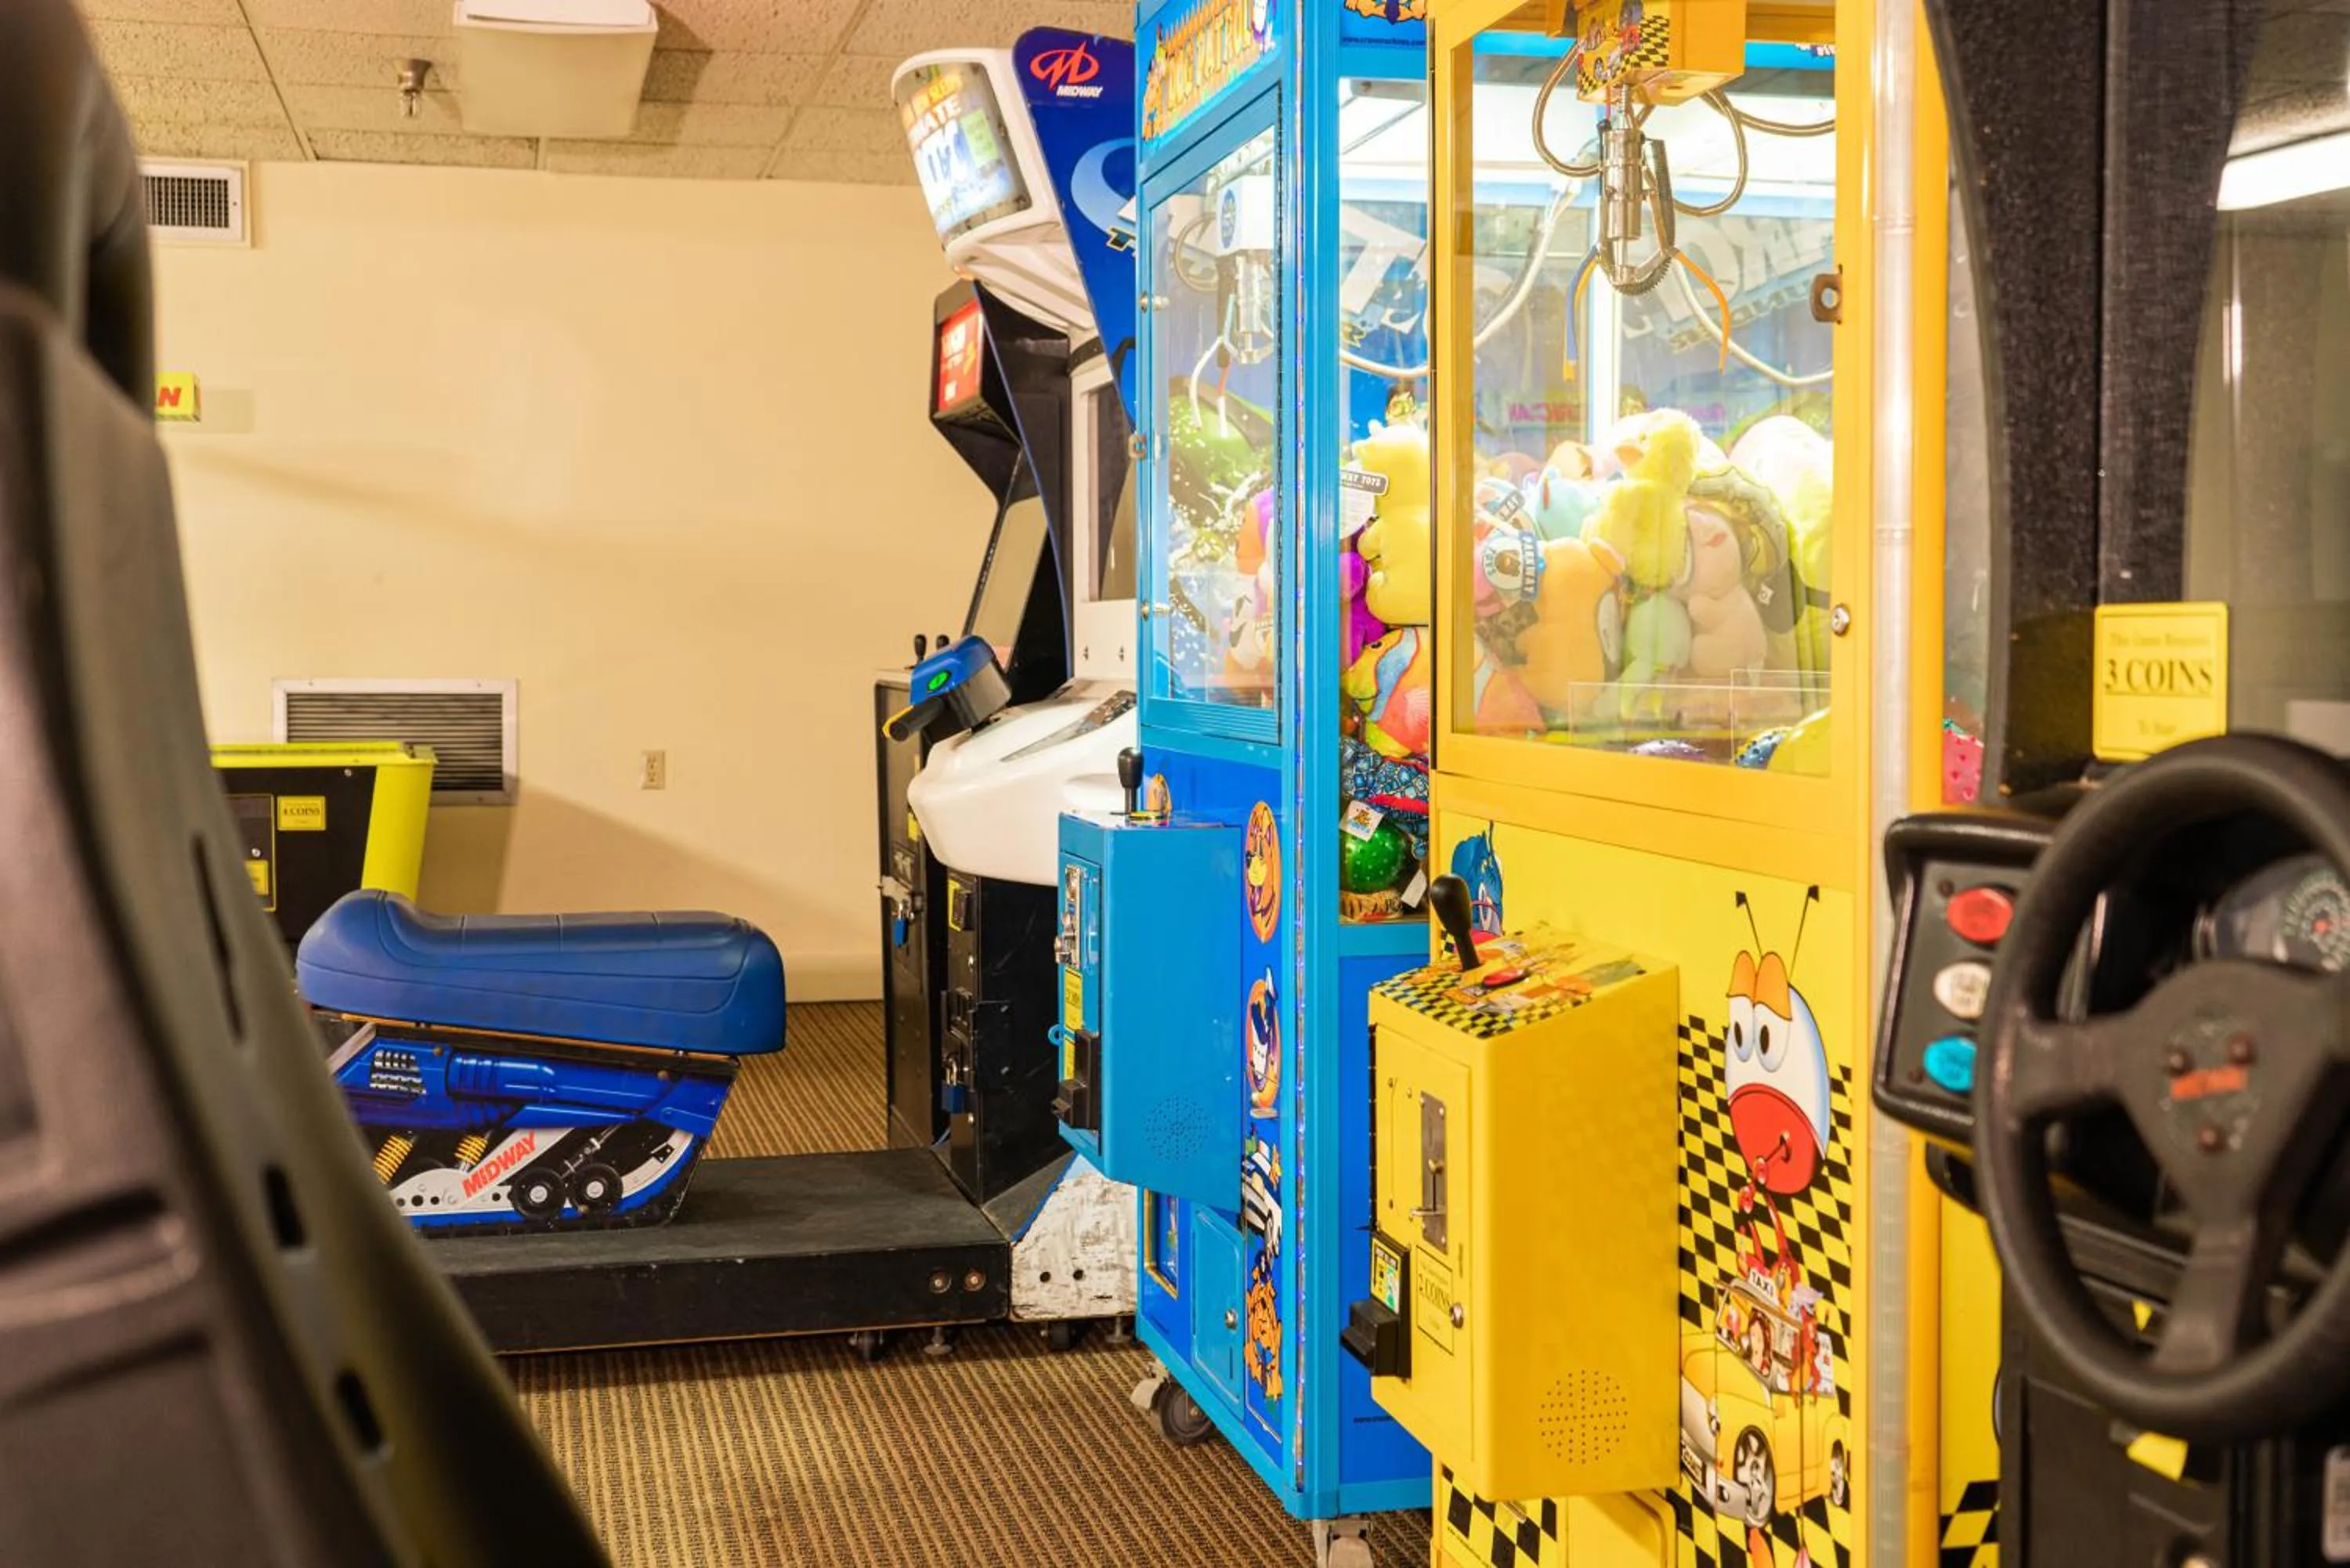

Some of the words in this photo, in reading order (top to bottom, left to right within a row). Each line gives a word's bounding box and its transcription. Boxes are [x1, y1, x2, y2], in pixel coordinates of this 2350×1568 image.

[1057, 85, 1104, 97] MIDWAY
[2105, 659, 2117, 691] 3
[2126, 659, 2213, 694] COINS
[462, 1129, 536, 1198] MIDWAY
[1752, 1270, 1775, 1298] TAXI
